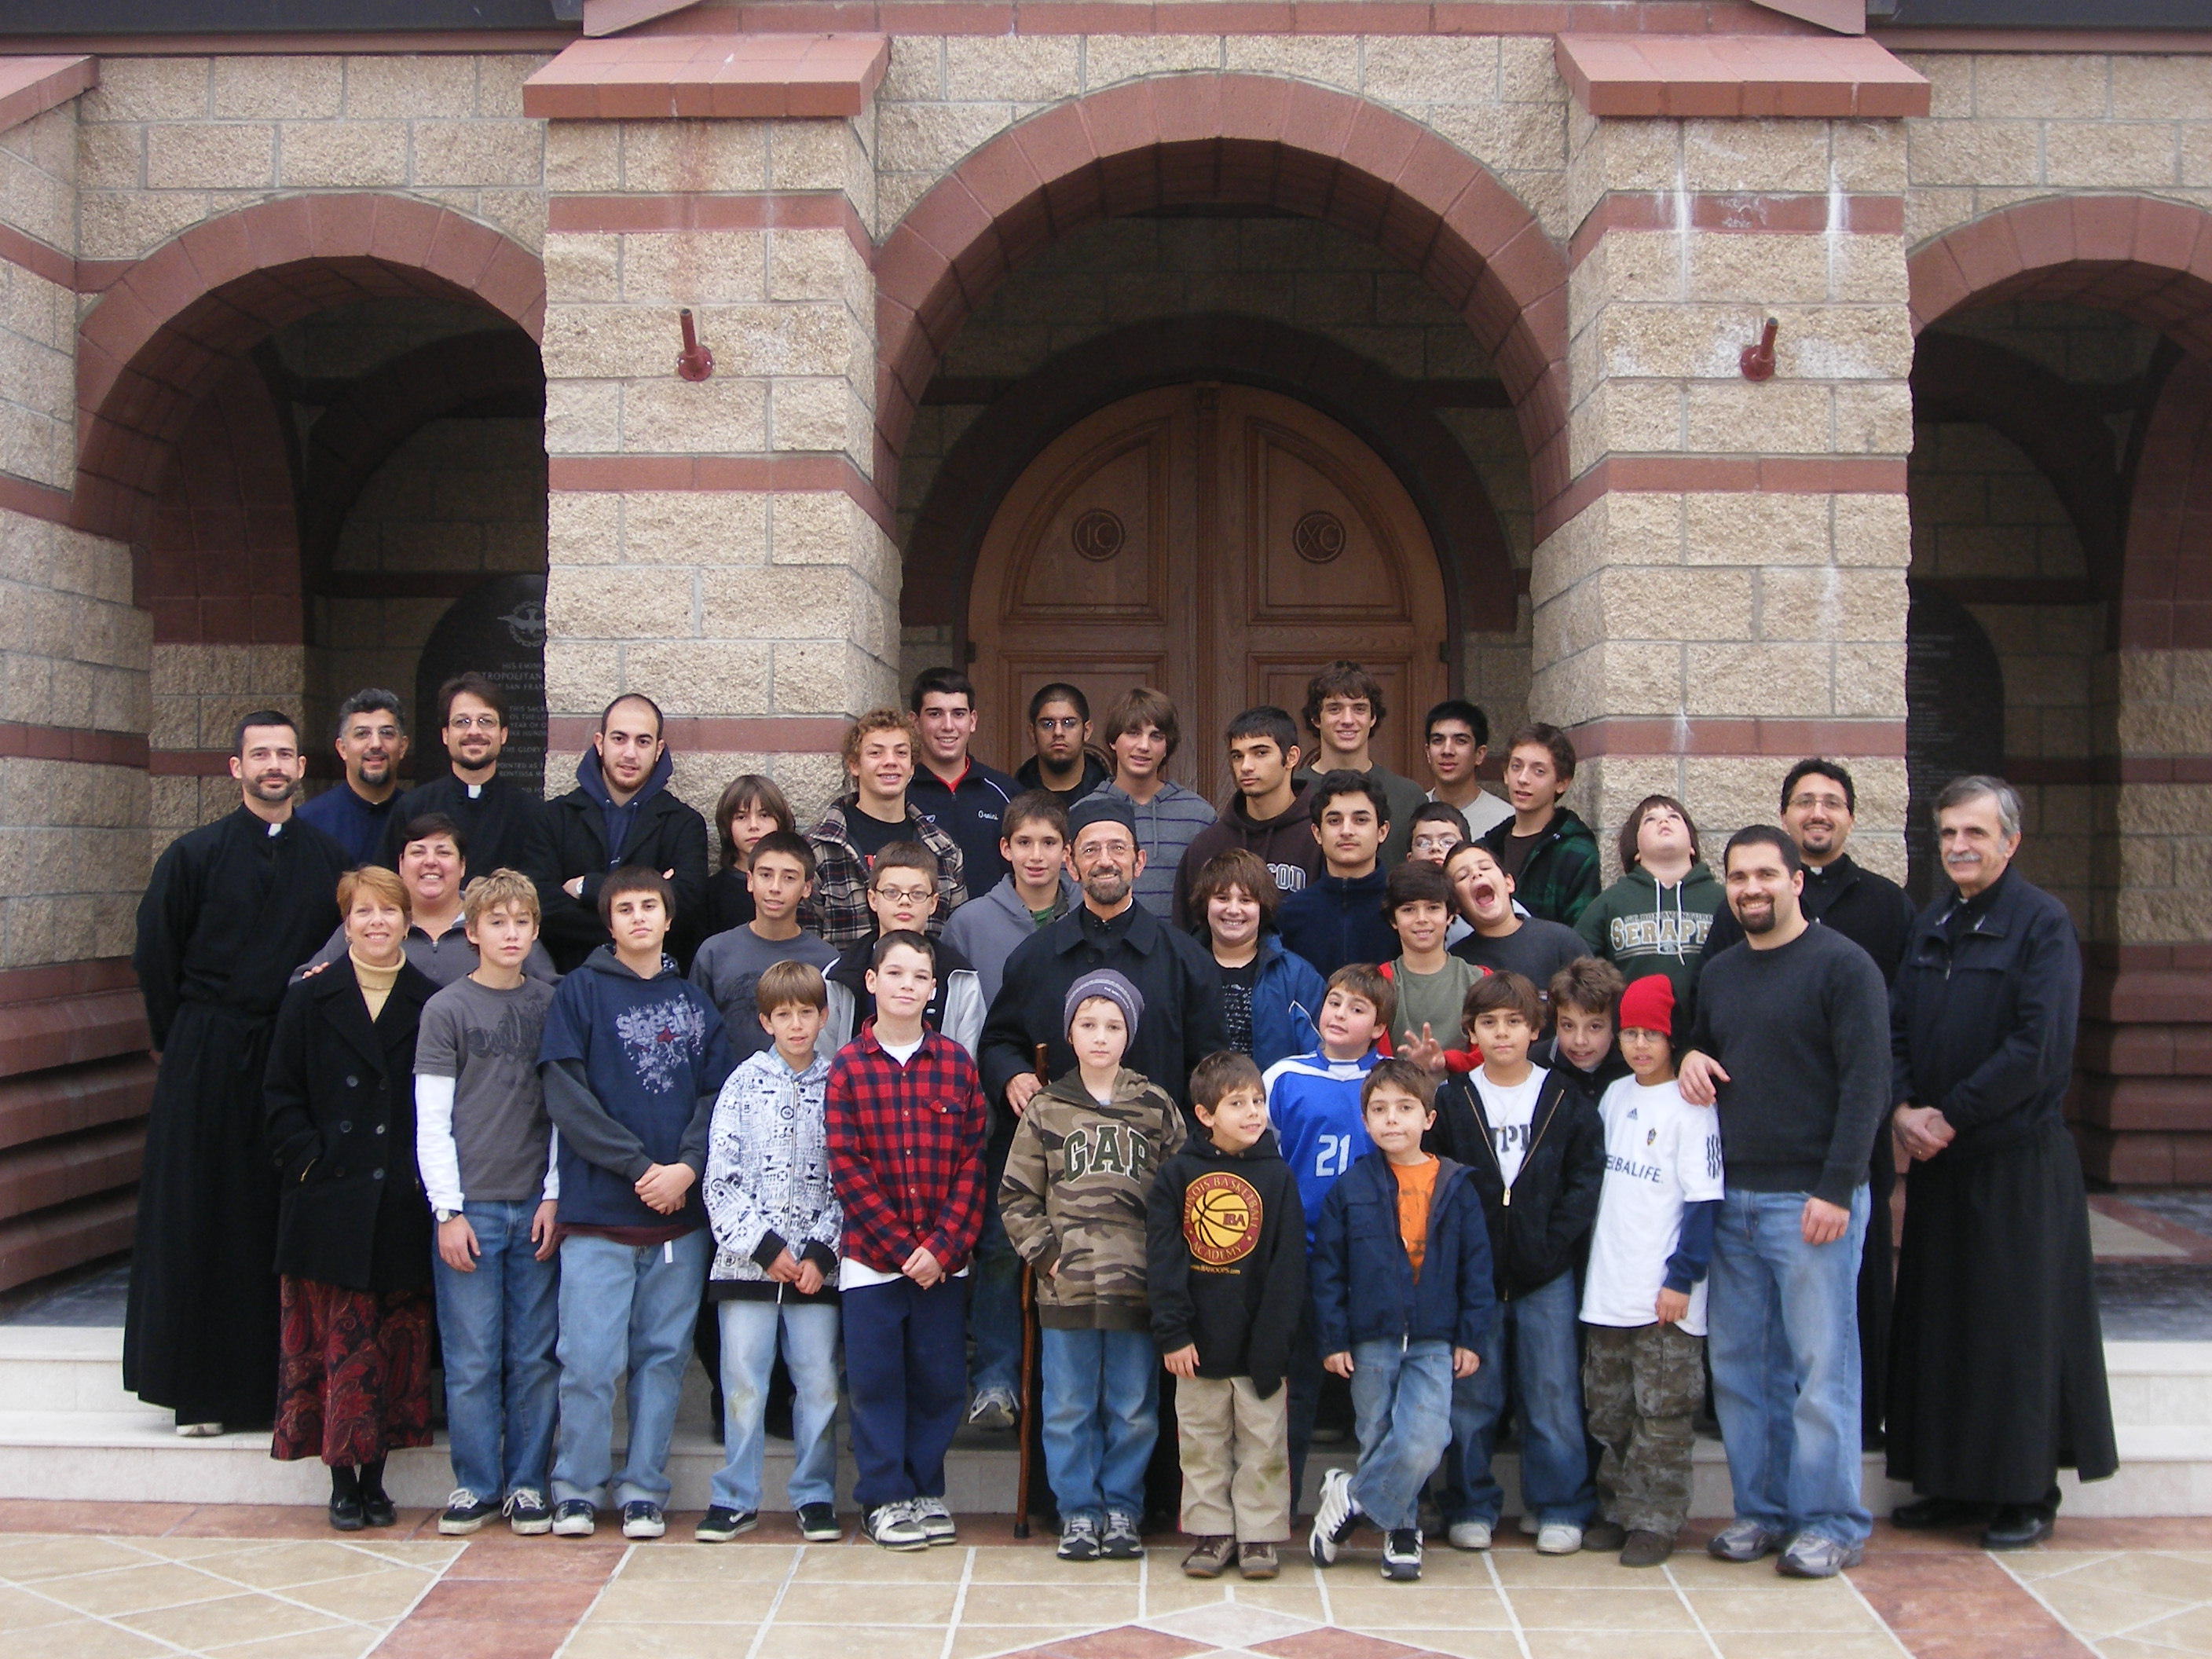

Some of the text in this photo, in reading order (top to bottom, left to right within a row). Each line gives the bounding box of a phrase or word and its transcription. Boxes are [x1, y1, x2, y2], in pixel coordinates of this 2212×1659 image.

[479, 672, 542, 680] TROPOLITAN
[1063, 1124, 1152, 1185] GAP
[1315, 1134, 1352, 1177] 21
[1213, 1176, 1259, 1228] BASKETBALL
[1192, 1240, 1242, 1261] ACADEMY
